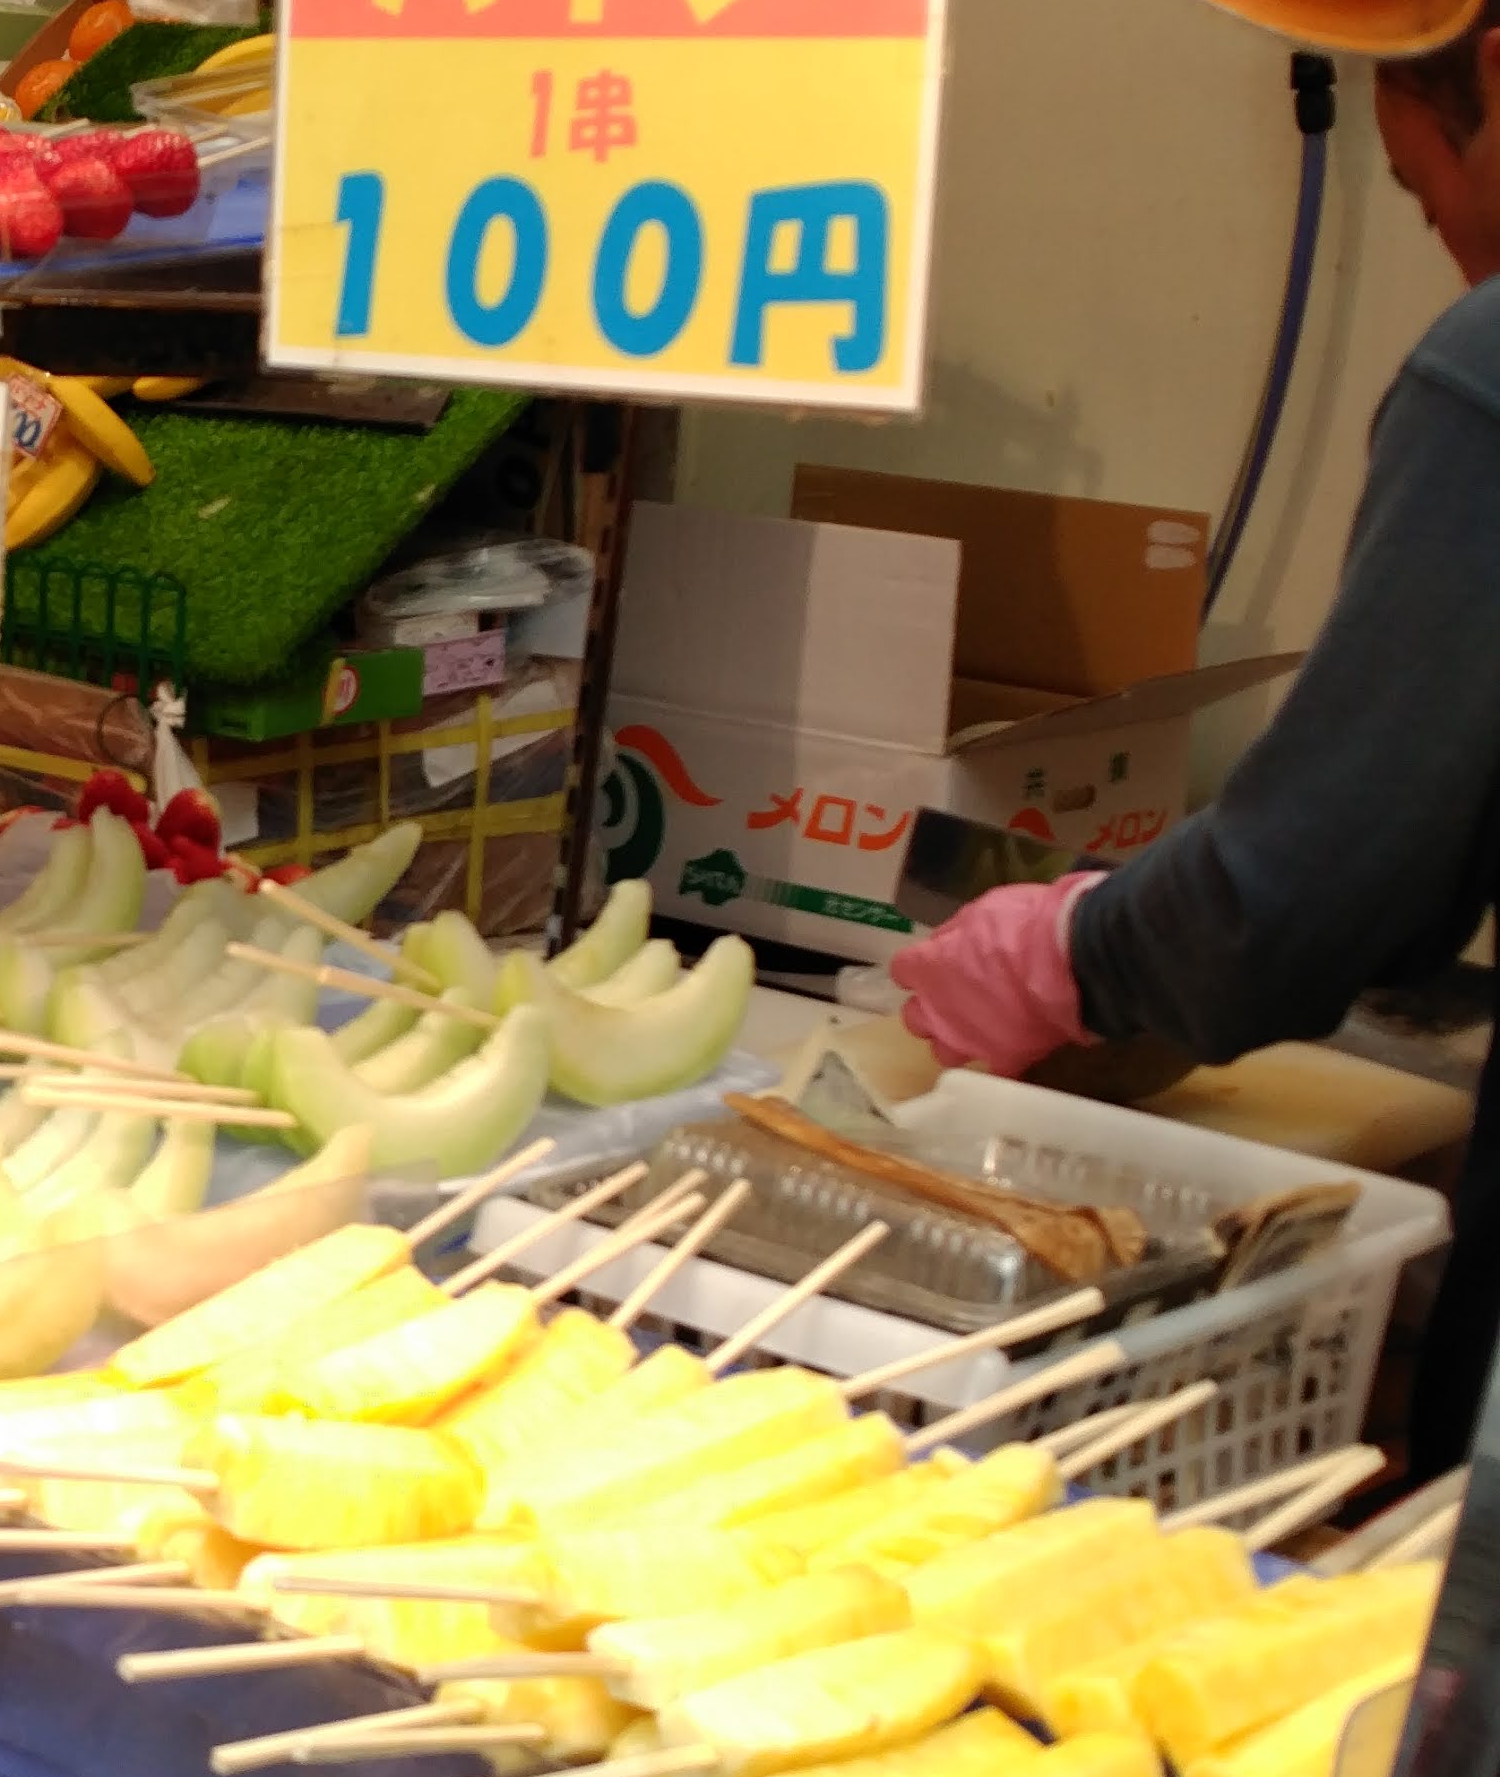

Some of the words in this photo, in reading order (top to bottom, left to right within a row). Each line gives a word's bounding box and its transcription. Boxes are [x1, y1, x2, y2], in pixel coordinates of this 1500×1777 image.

[530, 69, 638, 163] 1串
[336, 173, 889, 373] 100円
[745, 787, 913, 852] メロン
